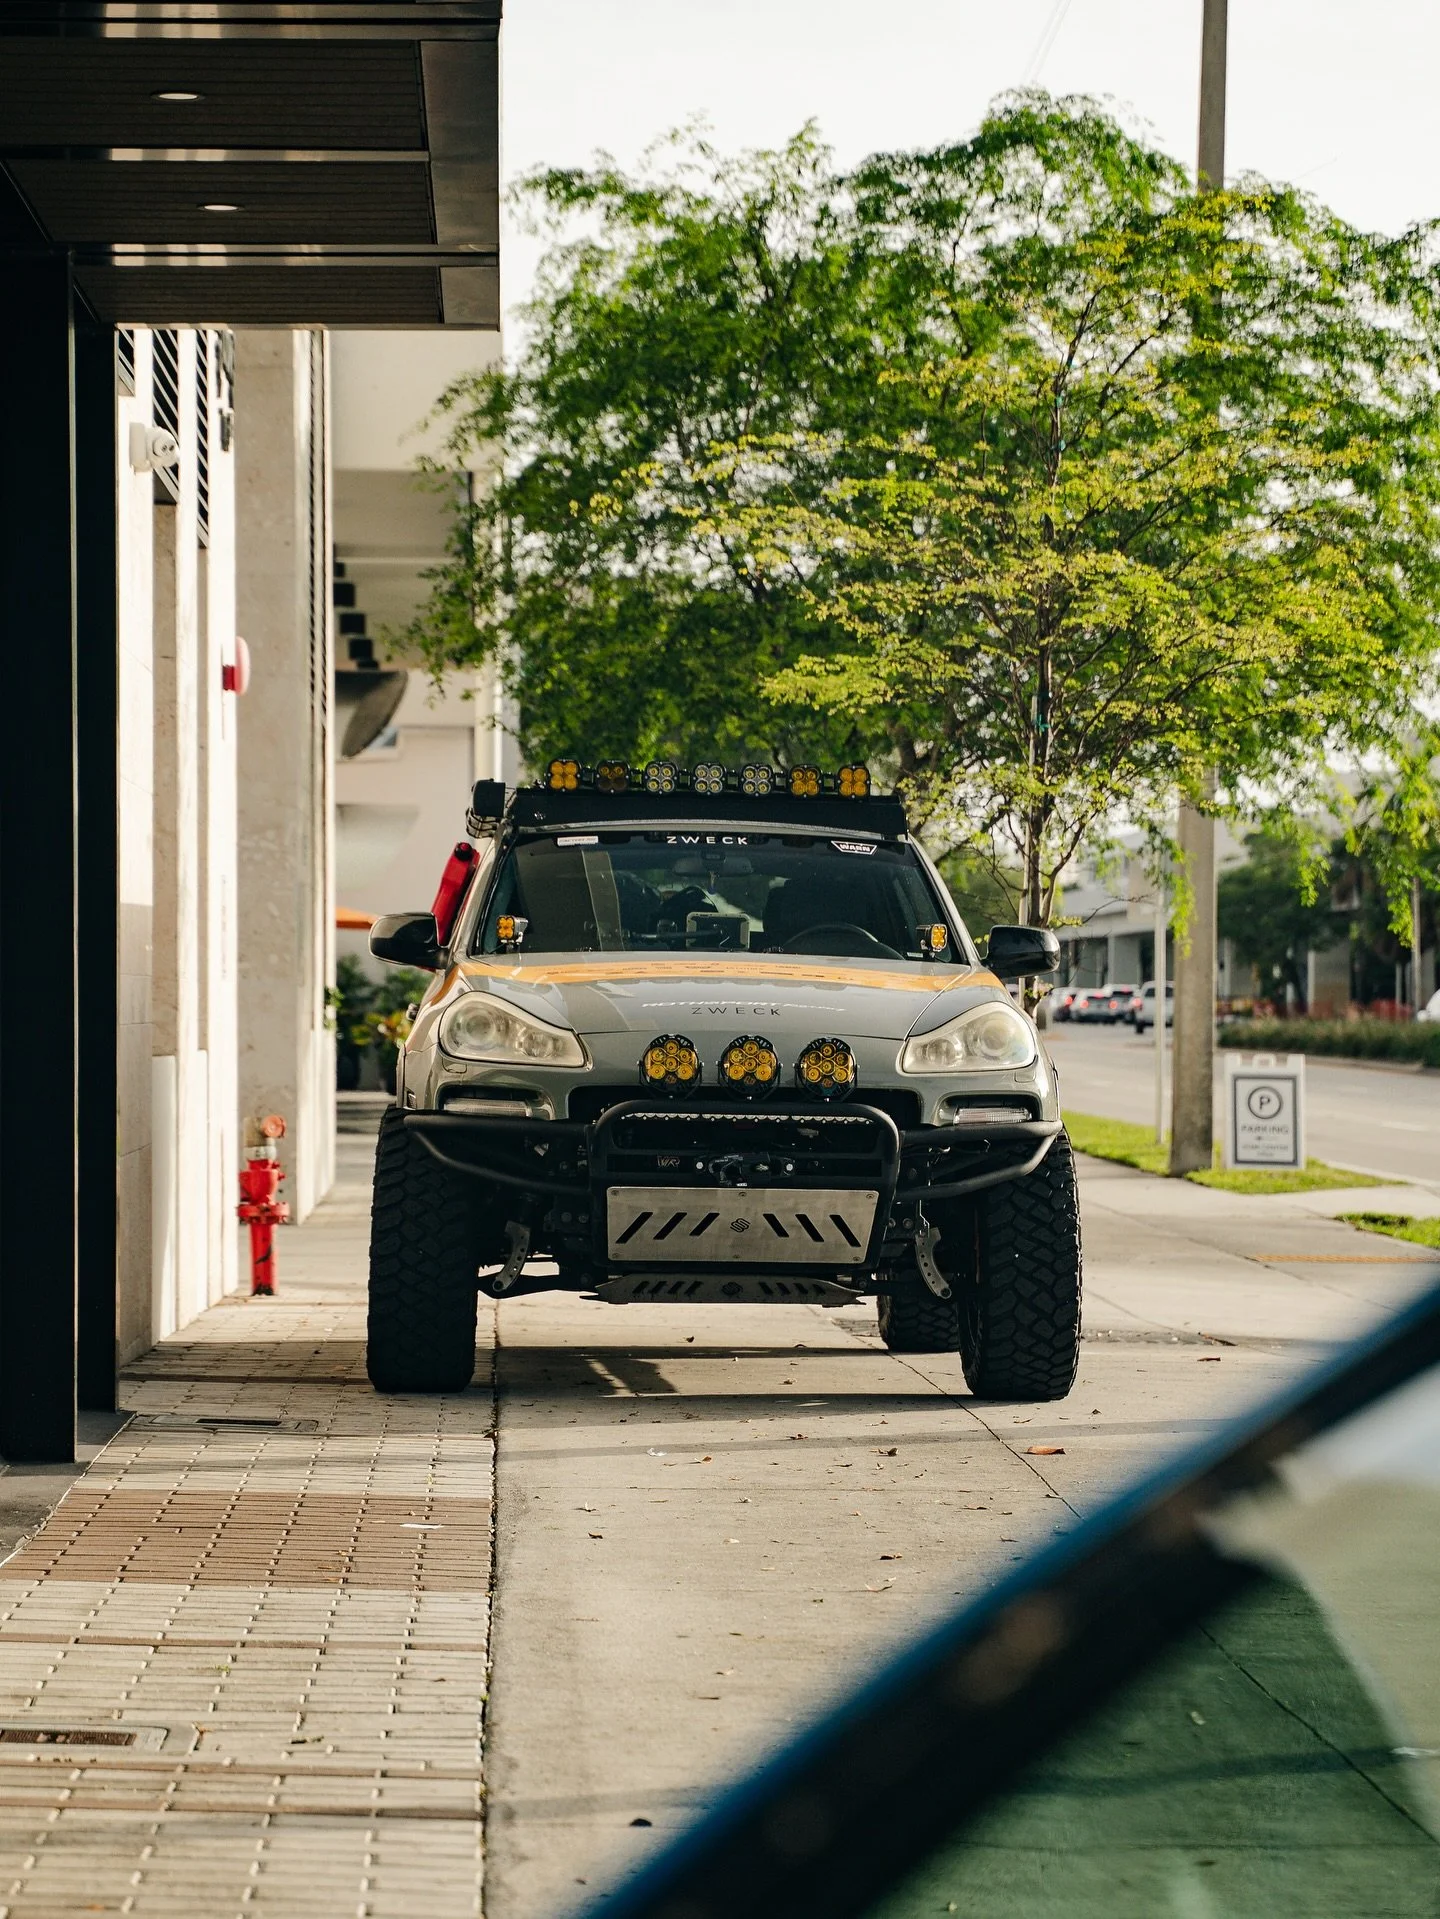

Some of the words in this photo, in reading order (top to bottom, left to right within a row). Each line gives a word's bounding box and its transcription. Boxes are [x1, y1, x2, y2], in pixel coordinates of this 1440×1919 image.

[666, 836, 748, 845] ZWECK
[839, 843, 871, 852] WARN
[691, 1007, 781, 1016] ZWECK
[1259, 1095, 1271, 1110] P
[1241, 1124, 1289, 1134] PARKING
